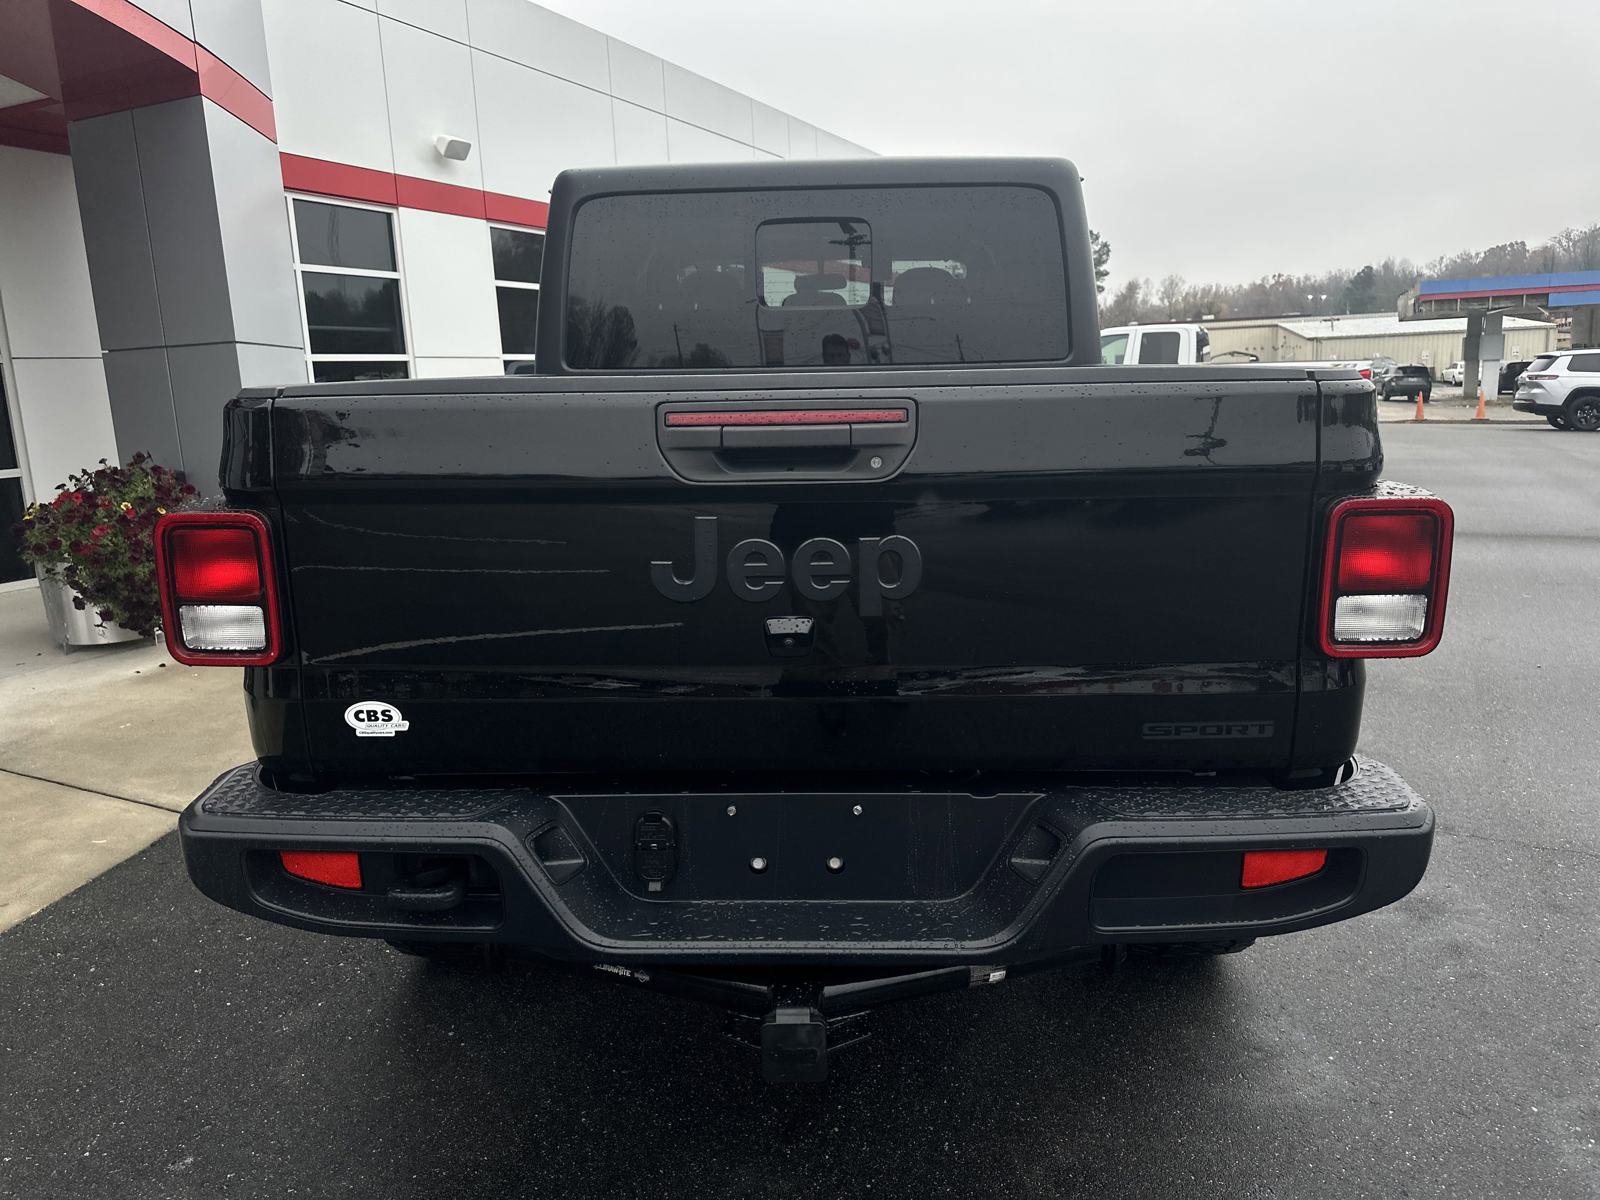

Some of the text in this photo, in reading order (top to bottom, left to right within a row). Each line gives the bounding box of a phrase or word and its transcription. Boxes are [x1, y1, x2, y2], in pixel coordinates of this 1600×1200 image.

[650, 515, 923, 617] Jeep
[353, 709, 394, 722] CBS
[1142, 722, 1274, 738] SPORT
